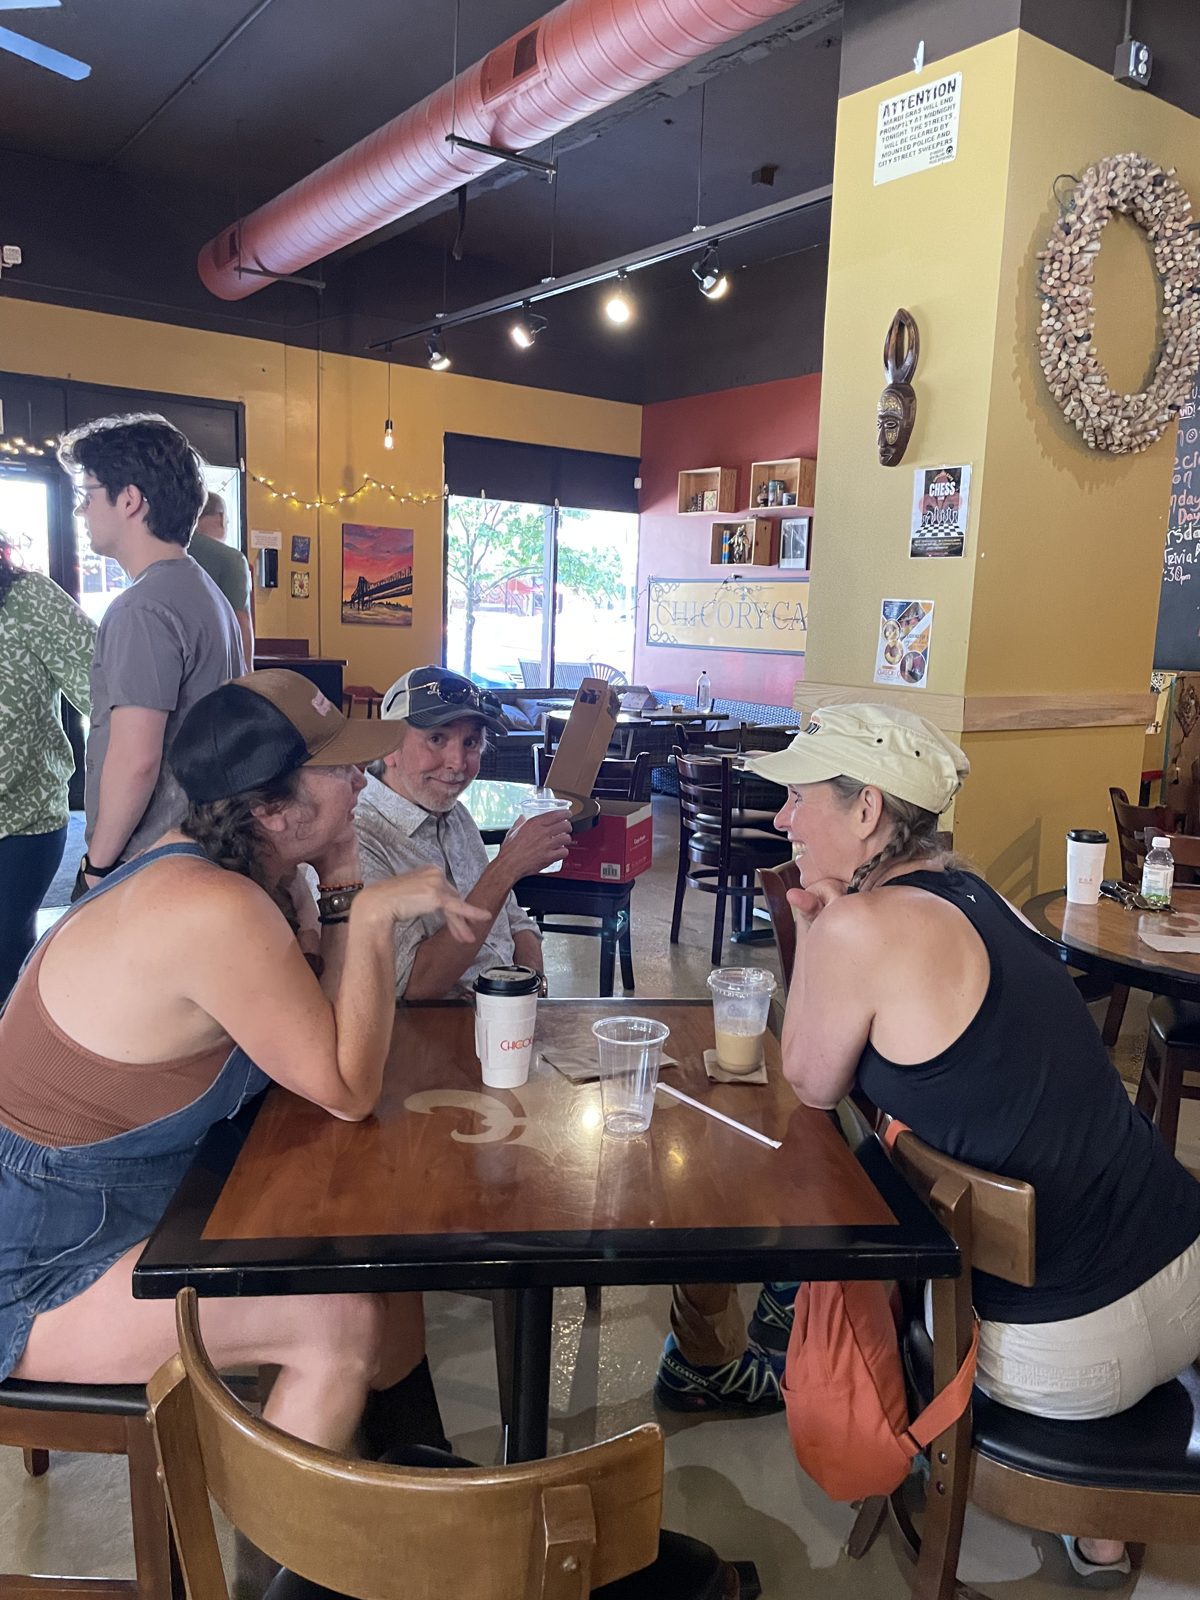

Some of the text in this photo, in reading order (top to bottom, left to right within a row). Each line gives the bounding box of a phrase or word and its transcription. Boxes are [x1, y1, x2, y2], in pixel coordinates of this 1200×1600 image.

[883, 78, 957, 119] ATTENTION
[883, 96, 953, 127] MARDI GRAS WILL END
[880, 103, 956, 136] PROMPTLY AT MIDNIGHT
[910, 123, 923, 133] THE
[924, 112, 953, 127] STREETS
[881, 130, 951, 159] MOUNTED POLICE AND
[884, 122, 949, 150] WILL BE CLEARED BY
[878, 159, 893, 168] CITY
[893, 150, 917, 163] STREET
[917, 137, 953, 155] SWEEPERS
[929, 481, 956, 497] CHESS
[1162, 565, 1191, 586] :30pm
[656, 600, 769, 630] CHICORY
